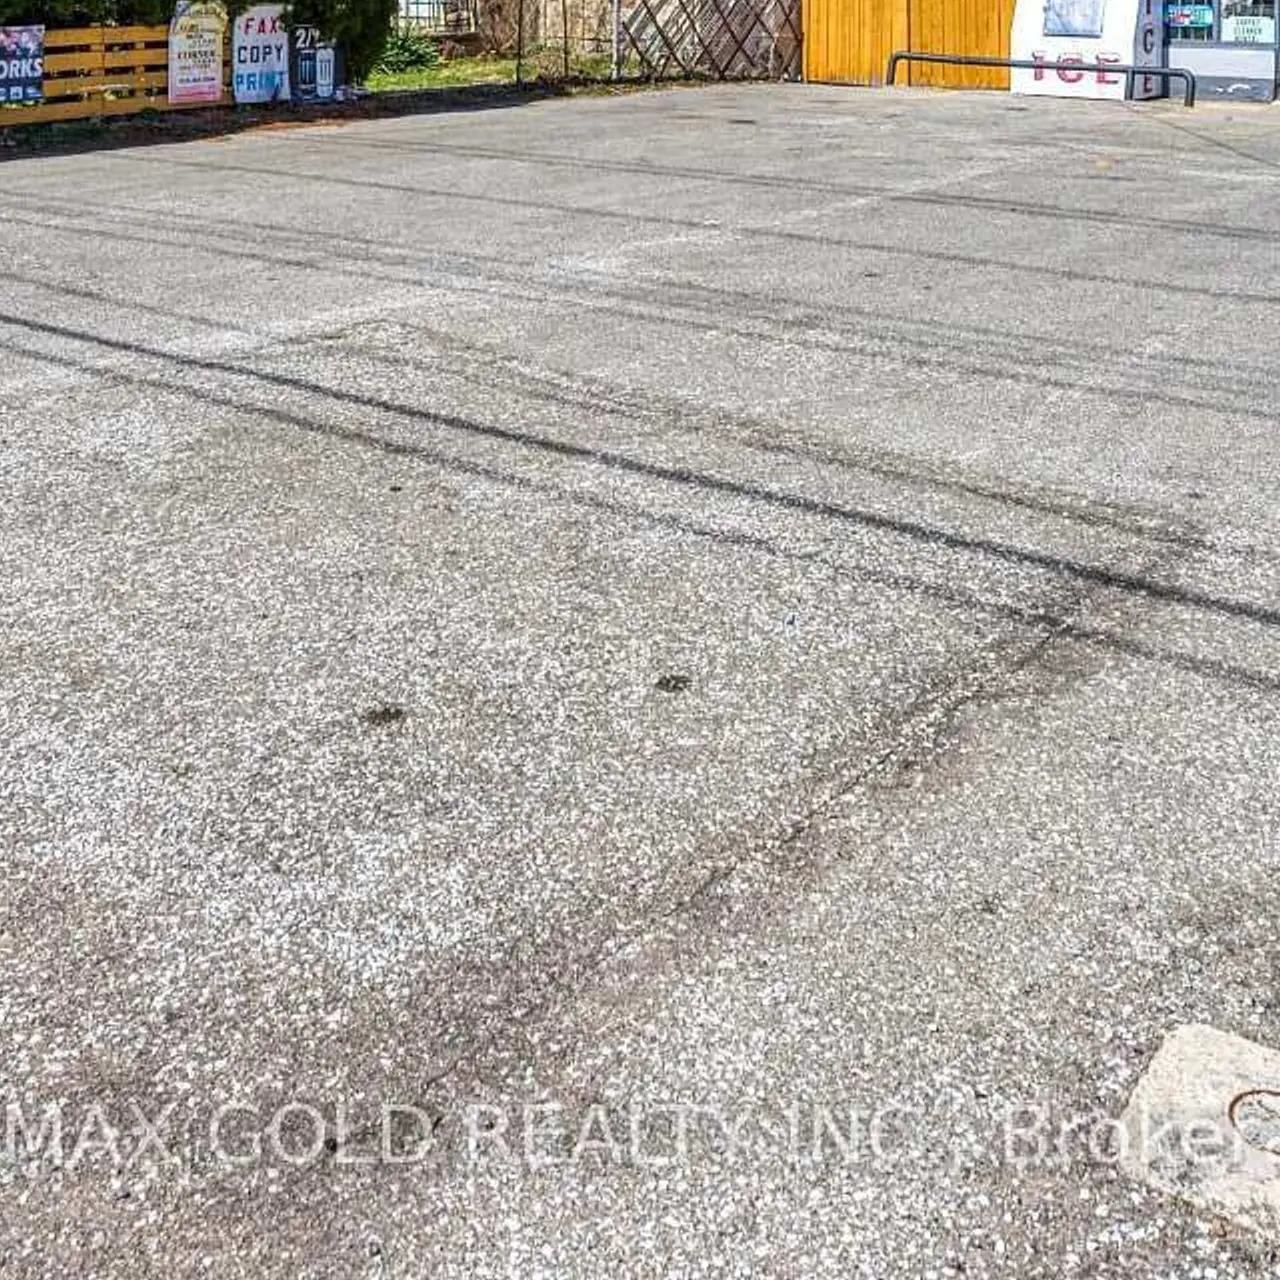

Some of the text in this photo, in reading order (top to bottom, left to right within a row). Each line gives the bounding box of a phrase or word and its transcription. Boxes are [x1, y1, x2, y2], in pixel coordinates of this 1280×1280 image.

[244, 17, 281, 35] FAX
[238, 44, 283, 63] COPY
[1032, 51, 1121, 83] ICE
[235, 70, 287, 92] PRINT
